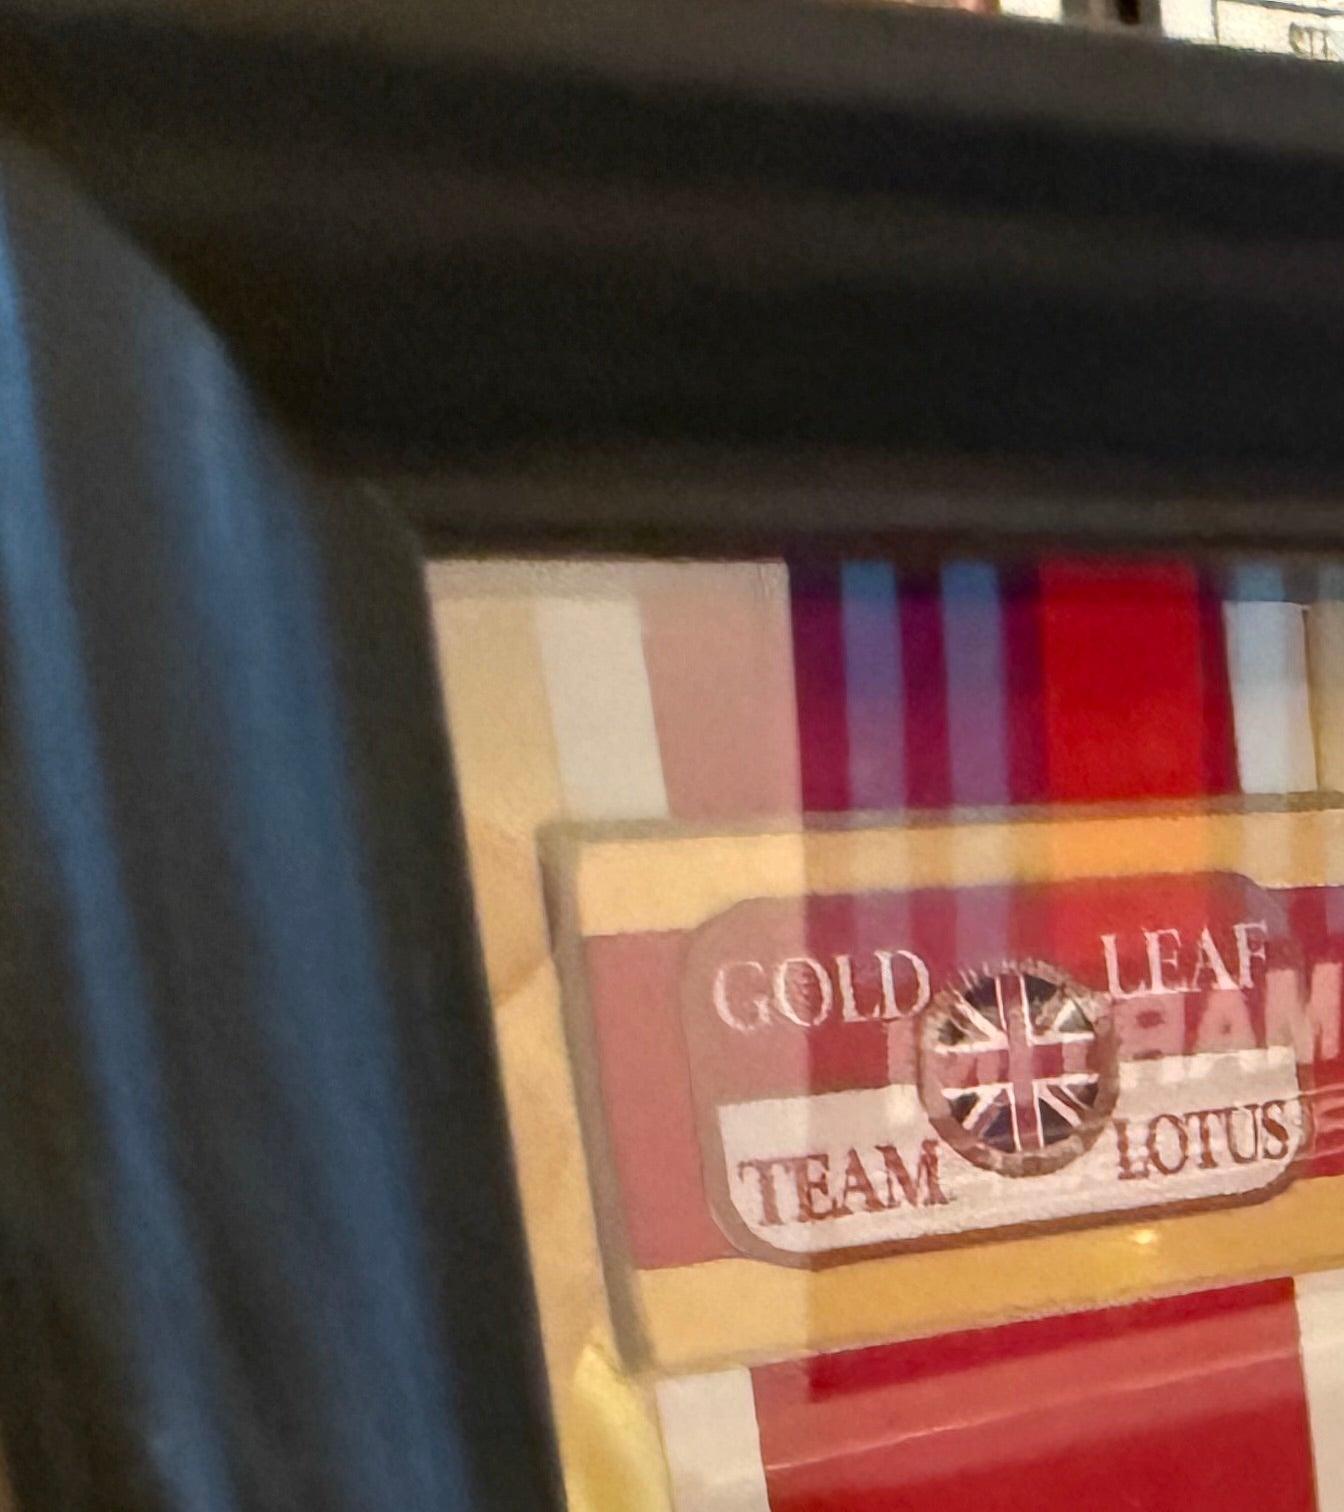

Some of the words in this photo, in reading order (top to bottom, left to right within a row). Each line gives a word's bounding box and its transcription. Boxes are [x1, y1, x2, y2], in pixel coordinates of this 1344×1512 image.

[712, 948, 931, 1033] GOLD
[1101, 919, 1269, 1001] LEAF
[737, 1138, 952, 1228] TEAM
[1113, 1100, 1291, 1181] LOTUS
